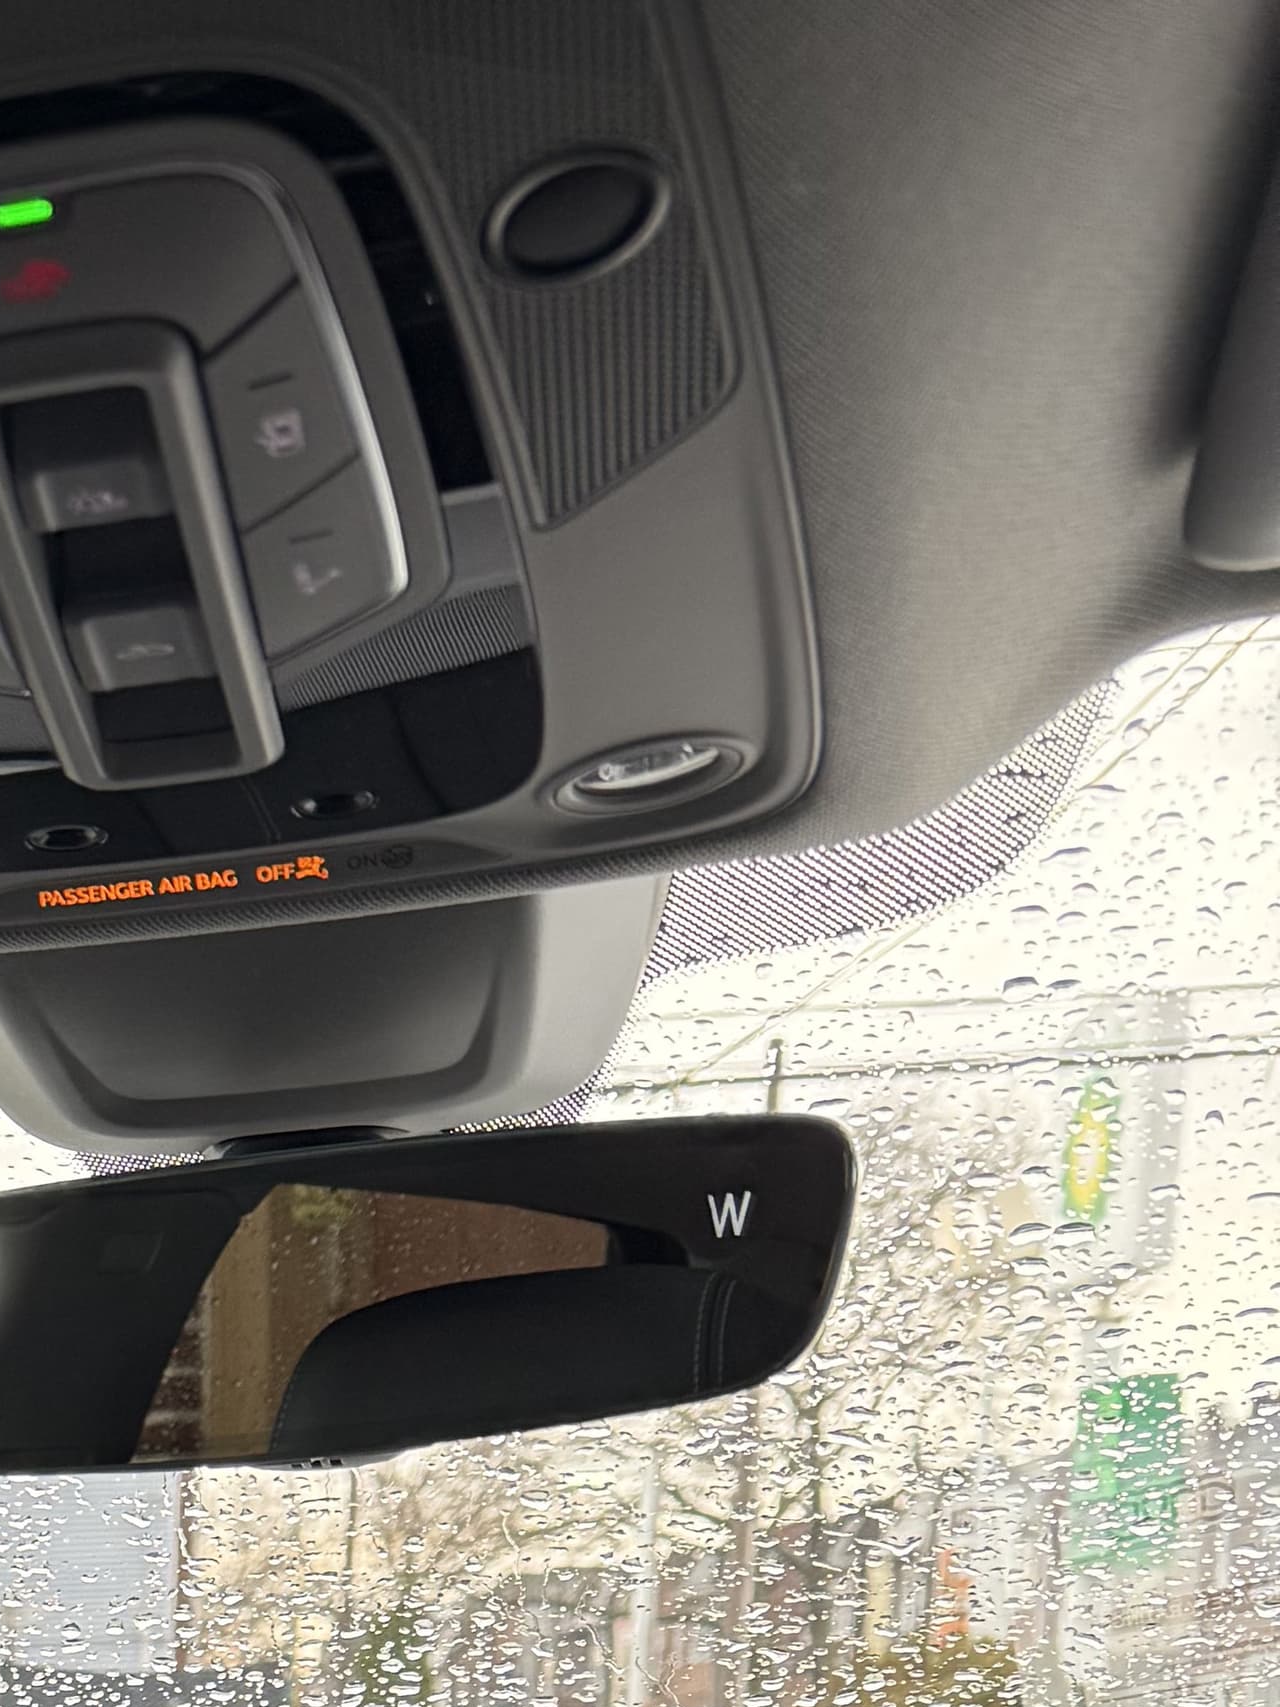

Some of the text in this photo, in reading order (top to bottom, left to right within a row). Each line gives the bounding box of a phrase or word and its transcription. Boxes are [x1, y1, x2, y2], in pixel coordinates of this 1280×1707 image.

[39, 862, 295, 908] PASSENGER AIR BAG OFF
[707, 1190, 752, 1239] W
